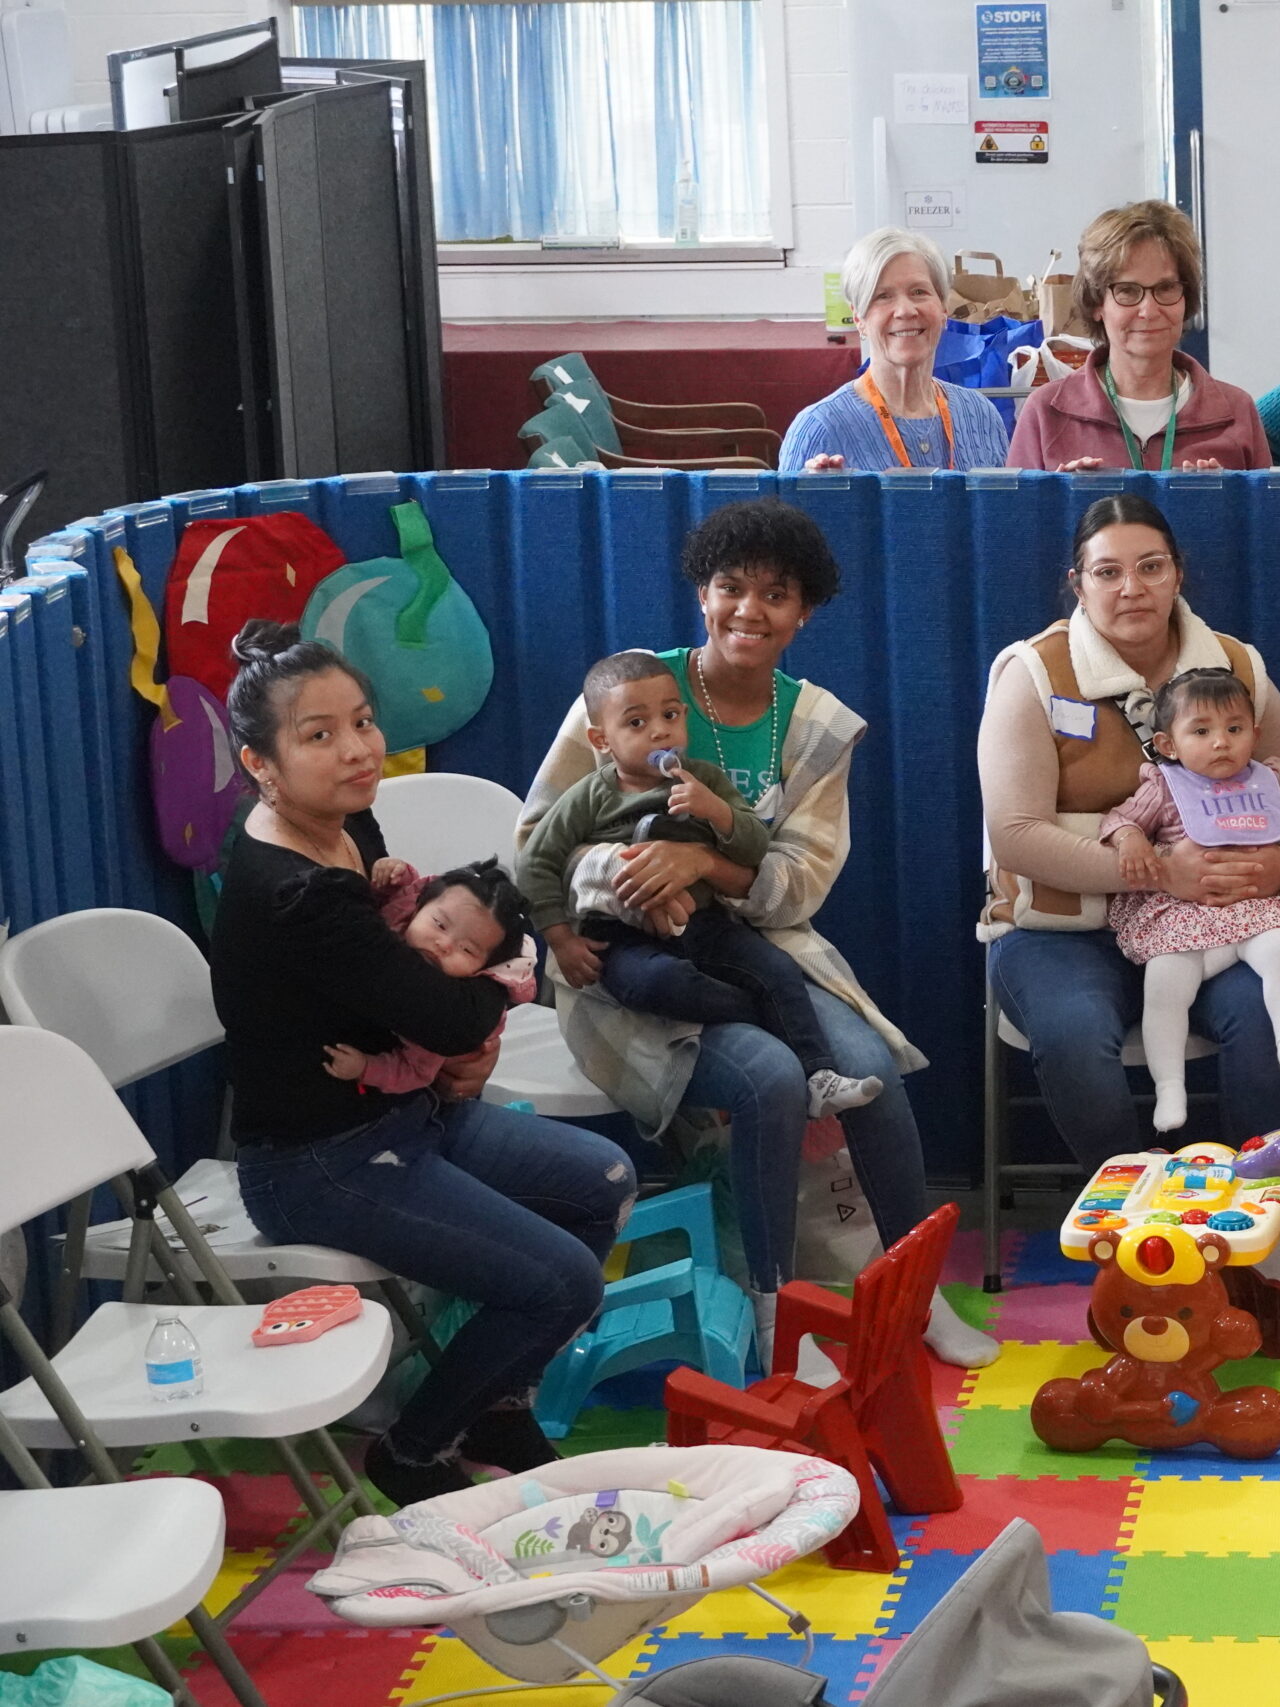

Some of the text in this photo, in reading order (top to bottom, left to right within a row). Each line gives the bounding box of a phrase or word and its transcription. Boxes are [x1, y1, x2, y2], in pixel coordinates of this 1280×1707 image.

[993, 10, 1042, 23] STOPit
[908, 206, 951, 215] FREEZER
[1201, 792, 1270, 817] LITTLE
[1216, 816, 1265, 829] MIRACLE
